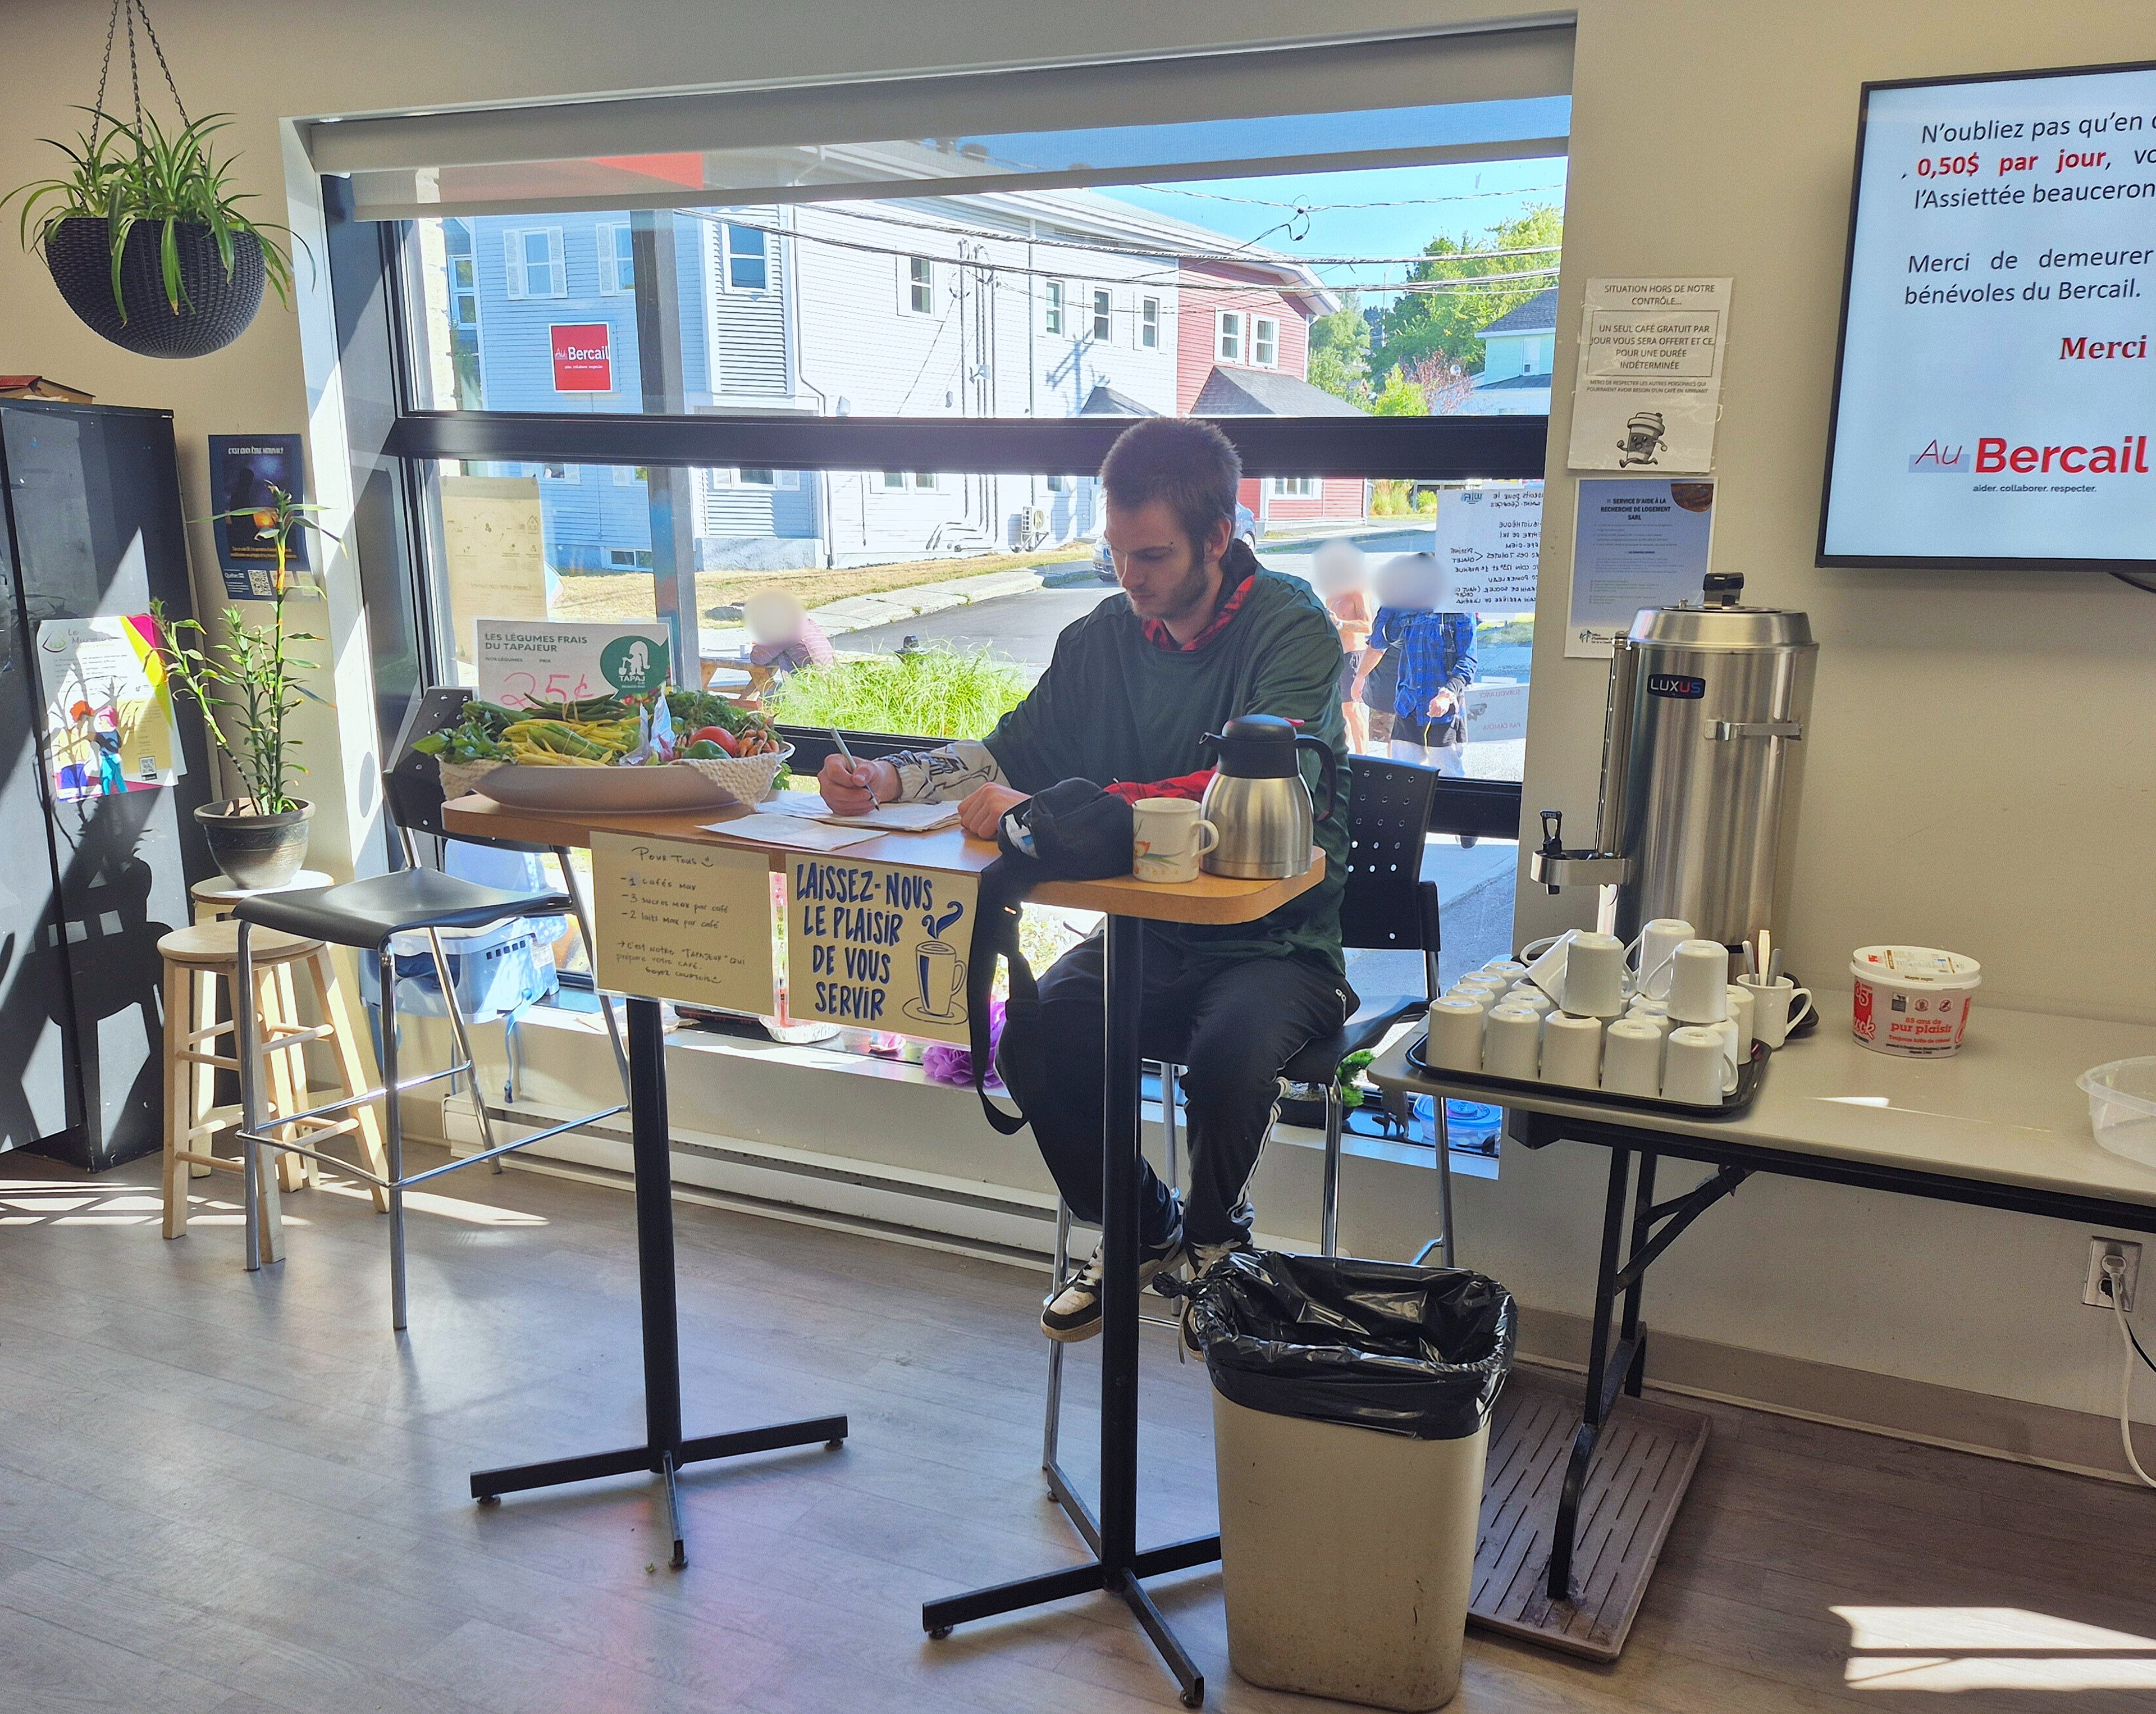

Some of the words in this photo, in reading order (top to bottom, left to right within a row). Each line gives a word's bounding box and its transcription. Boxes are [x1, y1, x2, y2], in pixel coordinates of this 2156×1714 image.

[2031, 118, 2070, 140] pas
[1917, 152, 1979, 180] 0,50$
[1998, 152, 2039, 176] par
[2055, 149, 2111, 173] jour,
[1908, 252, 1970, 273] Merci
[1990, 250, 2018, 270] de
[2039, 248, 2153, 268] demeurer
[1905, 283, 2015, 304] bénévoles
[2022, 281, 2050, 301] du
[2058, 279, 2140, 300] Bercail.
[1635, 324, 1655, 333] CAFÉ
[555, 348, 565, 358] Au
[568, 345, 610, 360] Bercail
[1660, 349, 1687, 357] DURÉE
[2059, 335, 2148, 360] Merci
[1620, 361, 1679, 370] INDÉTERMINÉE
[1915, 439, 1962, 465] Au
[1975, 436, 2149, 473] Bercail
[2000, 484, 2048, 493] collaborer.
[2050, 485, 2097, 494] respecter.
[485, 633, 503, 641] LES
[505, 632, 555, 643] LÉGUMES
[558, 636, 587, 644] FRAIS
[504, 643, 557, 652] TAPAJEUR
[1651, 678, 1701, 694] LUXUS
[671, 855, 697, 865] Tous
[804, 905, 825, 936] LE
[813, 945, 835, 975] DE
[845, 947, 891, 984] VOUS
[1891, 1023, 1913, 1032] pur
[1915, 1024, 1952, 1034] plaisir
